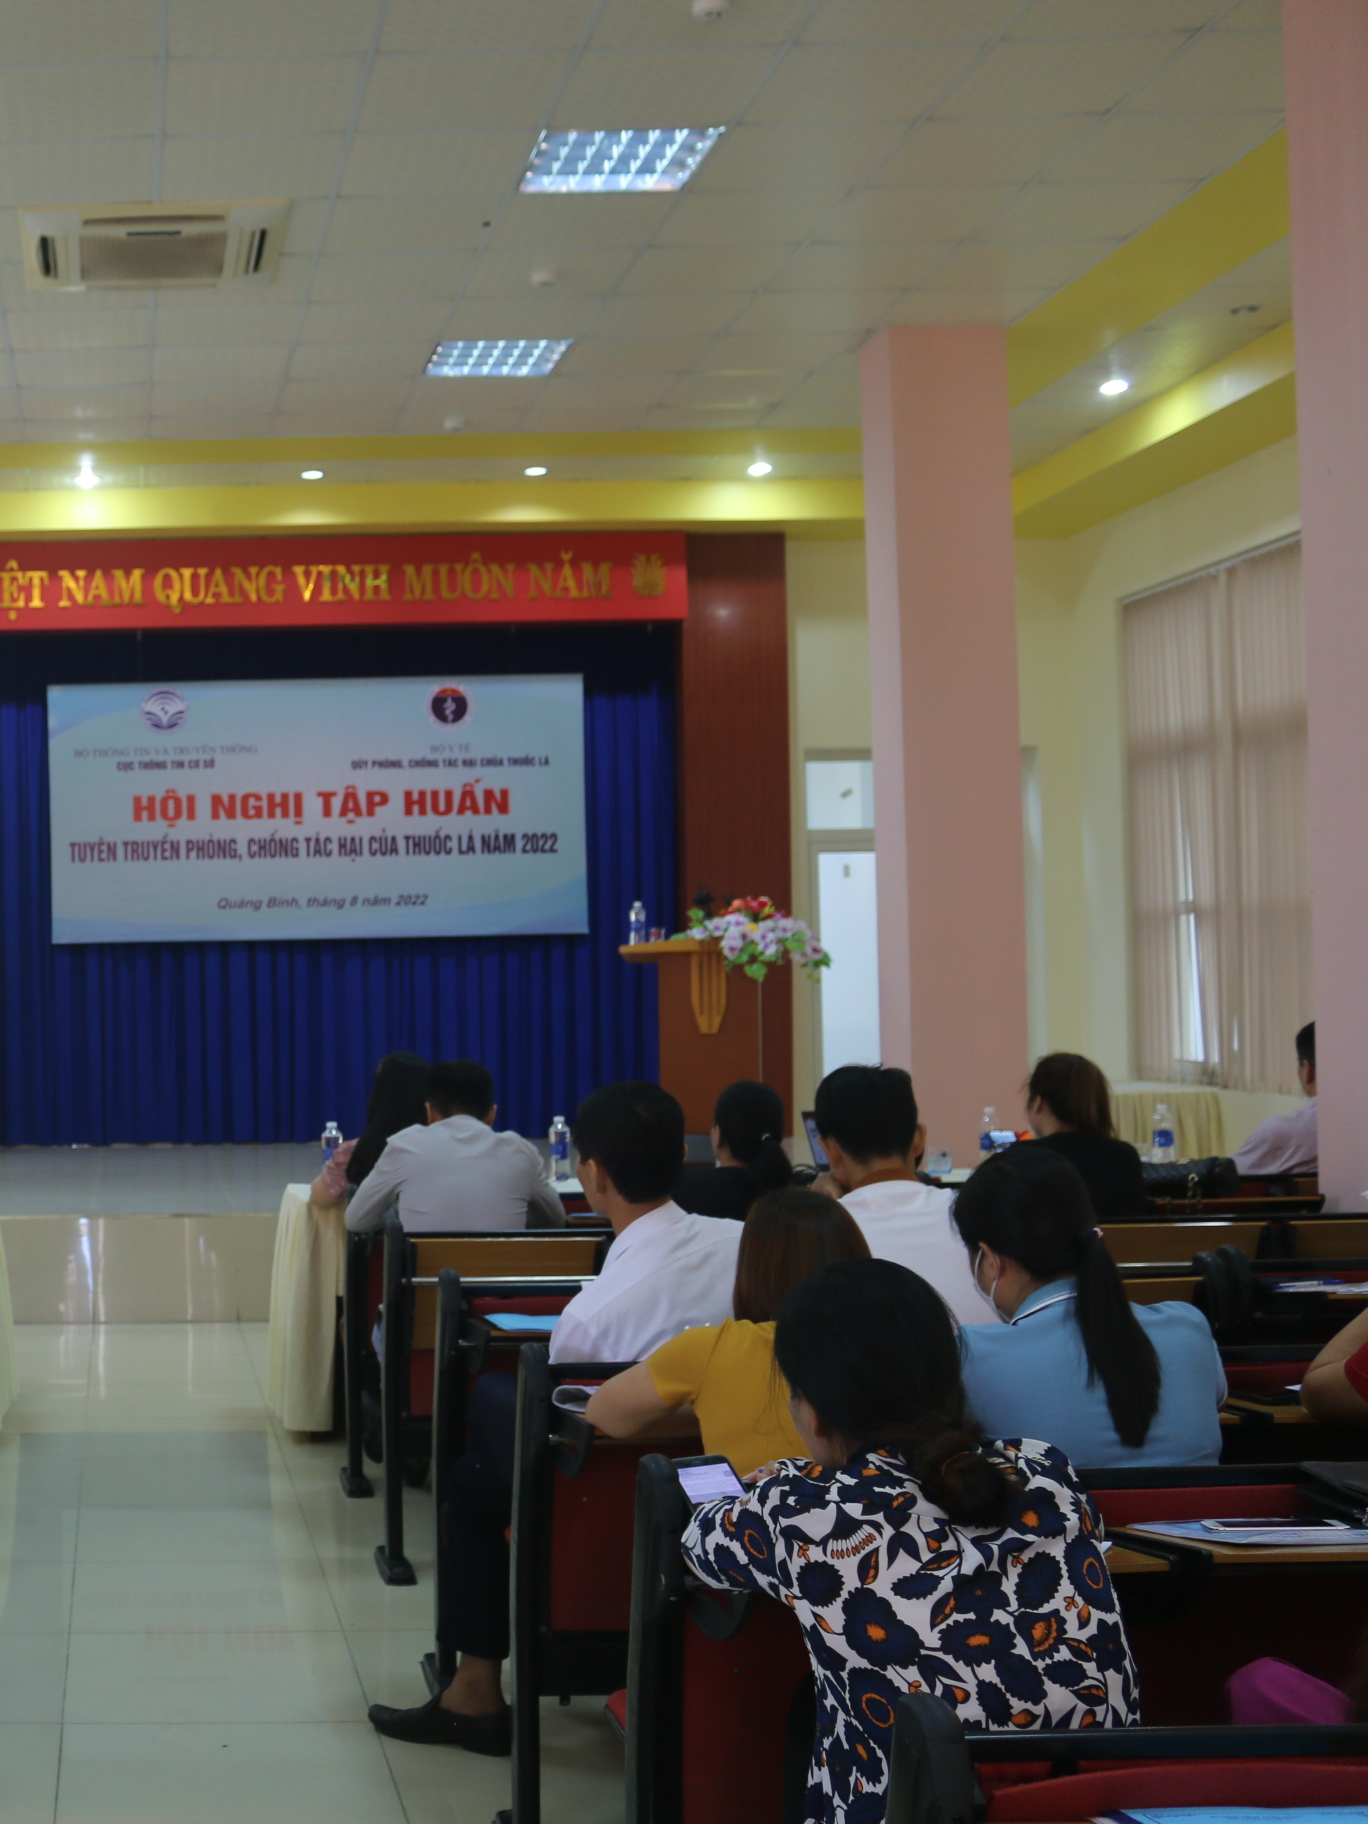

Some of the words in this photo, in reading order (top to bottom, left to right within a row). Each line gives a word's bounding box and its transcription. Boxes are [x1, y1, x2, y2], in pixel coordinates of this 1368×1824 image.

[58, 567, 144, 607] NAM
[153, 564, 285, 614] QUANG
[292, 564, 392, 603] VINH
[402, 552, 517, 601] MUÔN
[527, 551, 614, 599] NĂM
[132, 788, 197, 828] HỘI
[211, 791, 304, 825] NGHỊ
[316, 785, 390, 824] TẬP
[403, 778, 511, 817] HUẤN
[69, 836, 118, 863] TUYÊN
[247, 829, 300, 860] CHỐNG
[305, 831, 333, 858] TÁC
[338, 835, 364, 862] HẠI
[368, 827, 399, 857] CỦA
[404, 826, 454, 857] THUỐC
[458, 830, 476, 856] LÁ
[480, 829, 516, 855] NĂM
[521, 832, 559, 854] 2022
[306, 895, 347, 911] tháng
[395, 893, 429, 907] 2022
